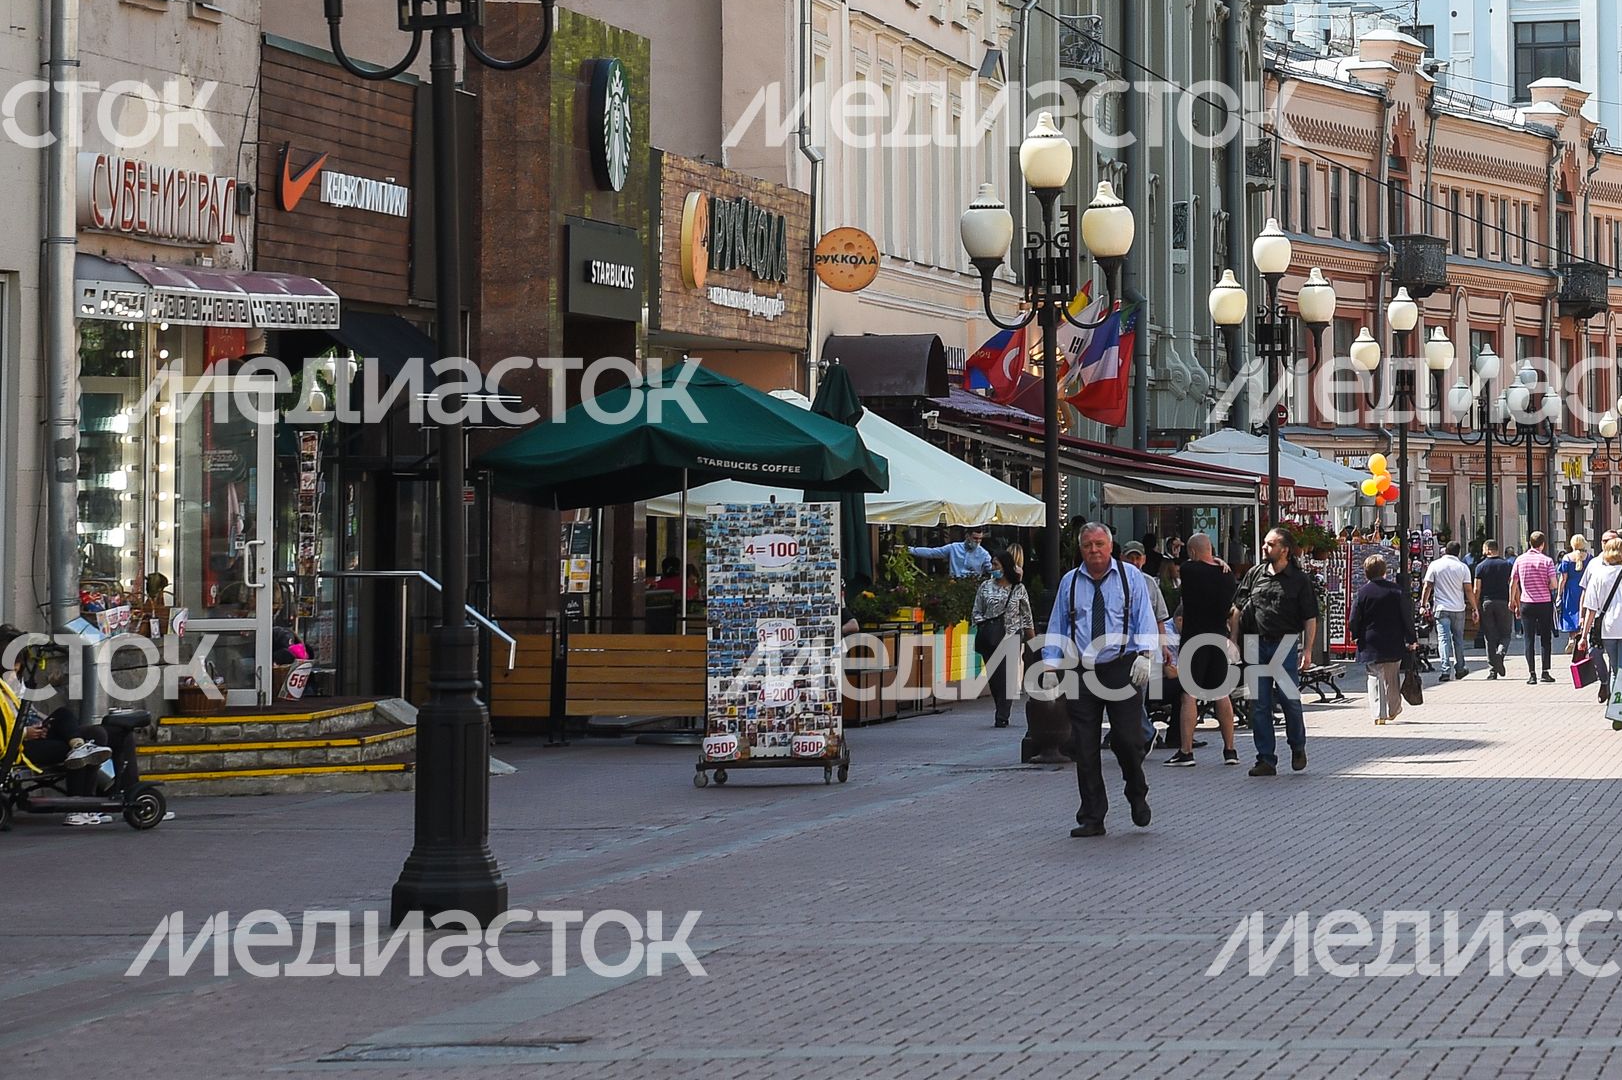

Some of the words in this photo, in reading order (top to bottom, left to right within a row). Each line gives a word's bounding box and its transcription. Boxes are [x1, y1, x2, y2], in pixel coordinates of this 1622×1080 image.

[711, 196, 788, 283] РУККОЛА
[814, 253, 877, 266] РУККОЛА
[590, 259, 635, 290] STARBUCKS
[697, 456, 759, 471] STARBUCKS
[761, 463, 801, 474] COFFEE
[745, 542, 797, 558] 4=100
[759, 628, 795, 642] 3=100
[289, 673, 309, 689] 55
